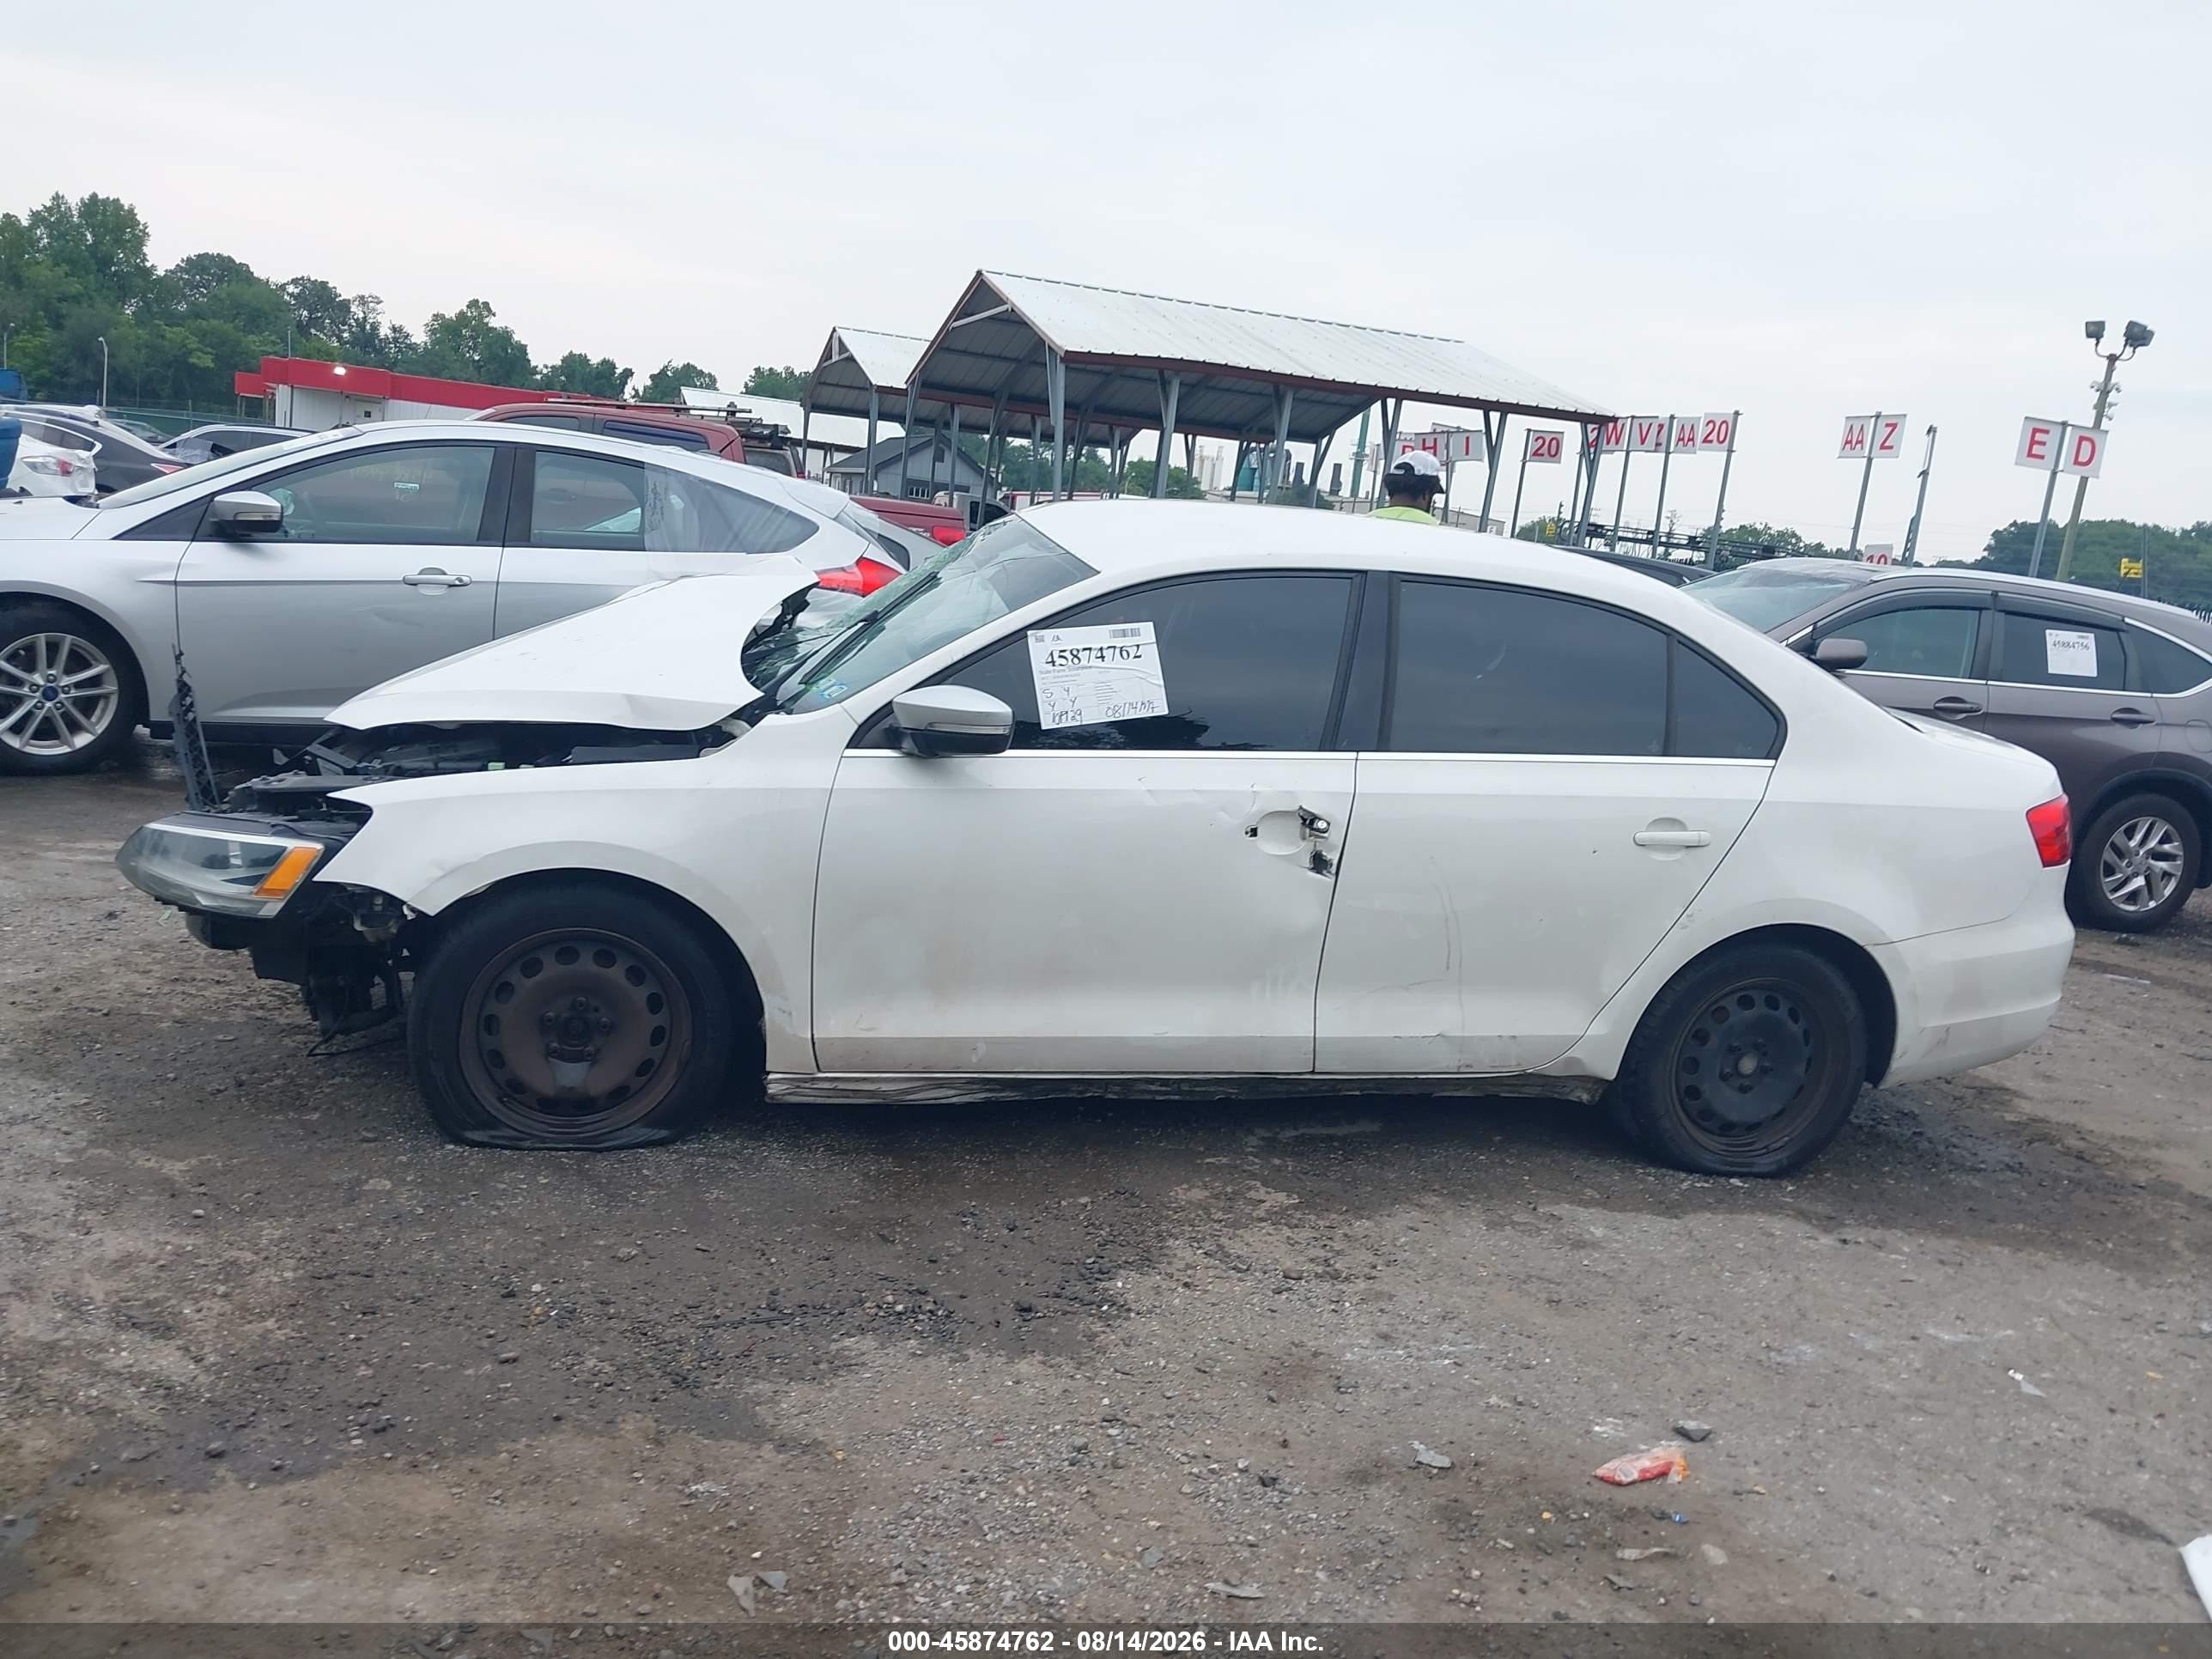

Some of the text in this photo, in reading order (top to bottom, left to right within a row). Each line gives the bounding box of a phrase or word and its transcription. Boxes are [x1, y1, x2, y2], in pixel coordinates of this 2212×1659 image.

[1604, 422, 1653, 446] W V
[1675, 423, 1695, 447] AA
[1701, 419, 1729, 445] 20
[1842, 422, 1898, 451] AA Z
[1421, 437, 1438, 457] H
[1464, 435, 1470, 456] I
[1531, 435, 1560, 458] 20
[2027, 427, 2096, 467] E D
[1044, 644, 1142, 667] 45874762
